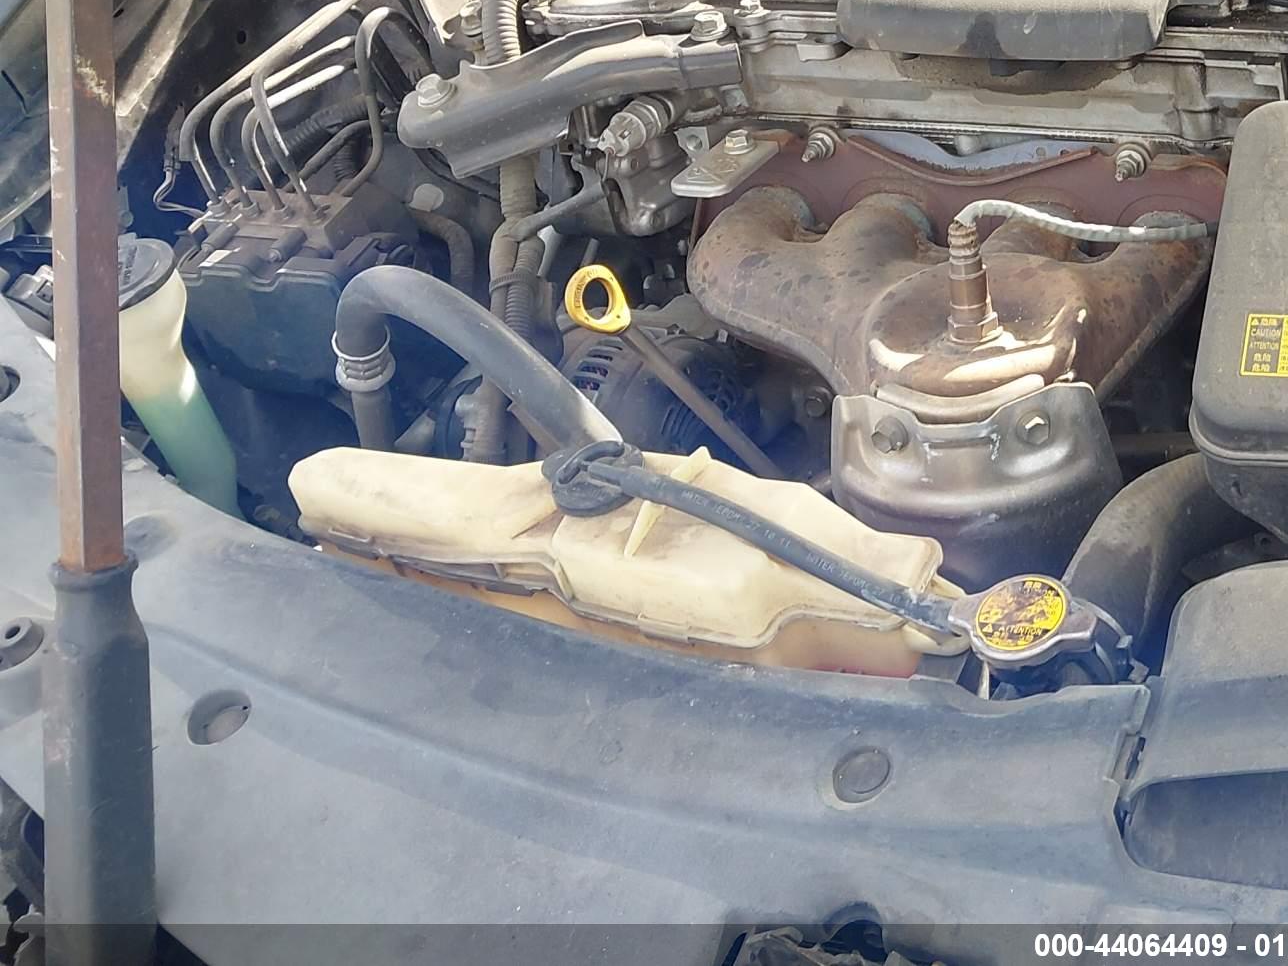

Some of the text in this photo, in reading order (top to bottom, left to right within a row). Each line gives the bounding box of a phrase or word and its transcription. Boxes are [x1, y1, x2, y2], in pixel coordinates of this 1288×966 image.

[1250, 328, 1281, 339] CAUTION
[1248, 340, 1280, 351] ATTENTION
[998, 624, 1043, 636] ATTENTION
